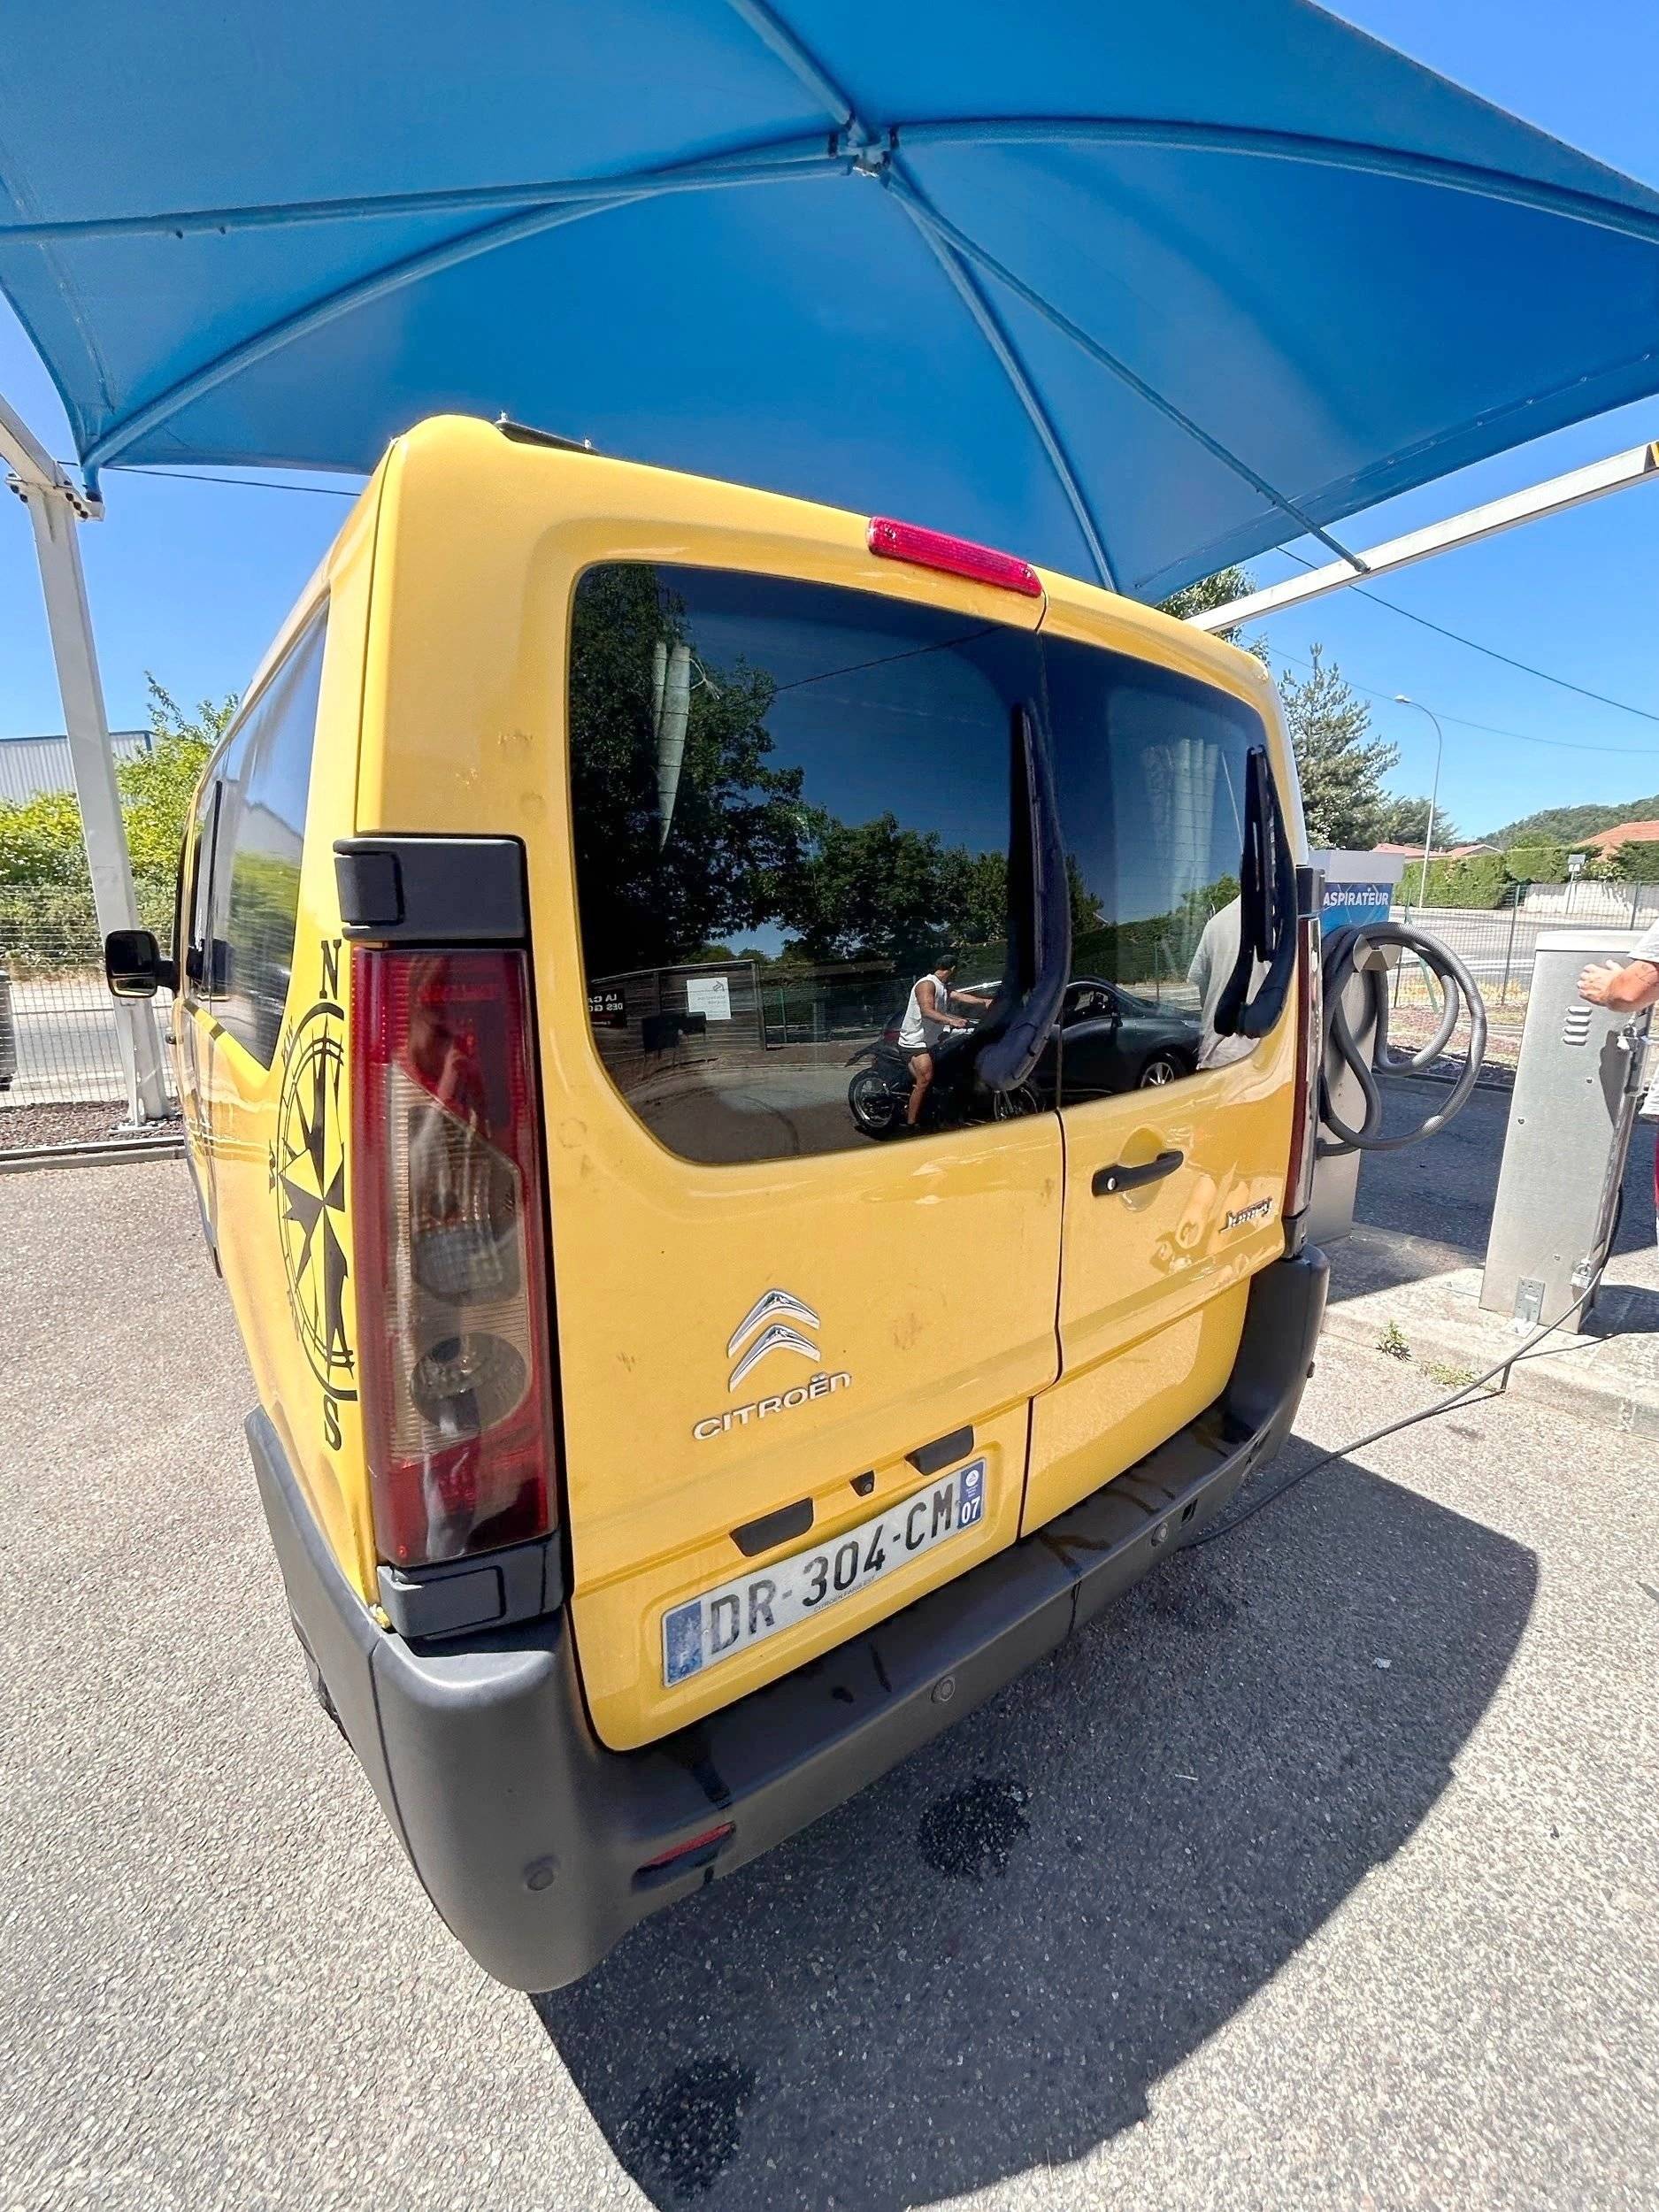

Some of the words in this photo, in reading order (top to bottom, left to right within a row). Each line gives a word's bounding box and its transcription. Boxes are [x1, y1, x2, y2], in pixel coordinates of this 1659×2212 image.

[1323, 891, 1389, 907] ASPIRATEUR
[319, 939, 342, 1001] N
[323, 1394, 342, 1451] S
[710, 1482, 955, 1655] DR-304-CM
[961, 1495, 981, 1524] 07
